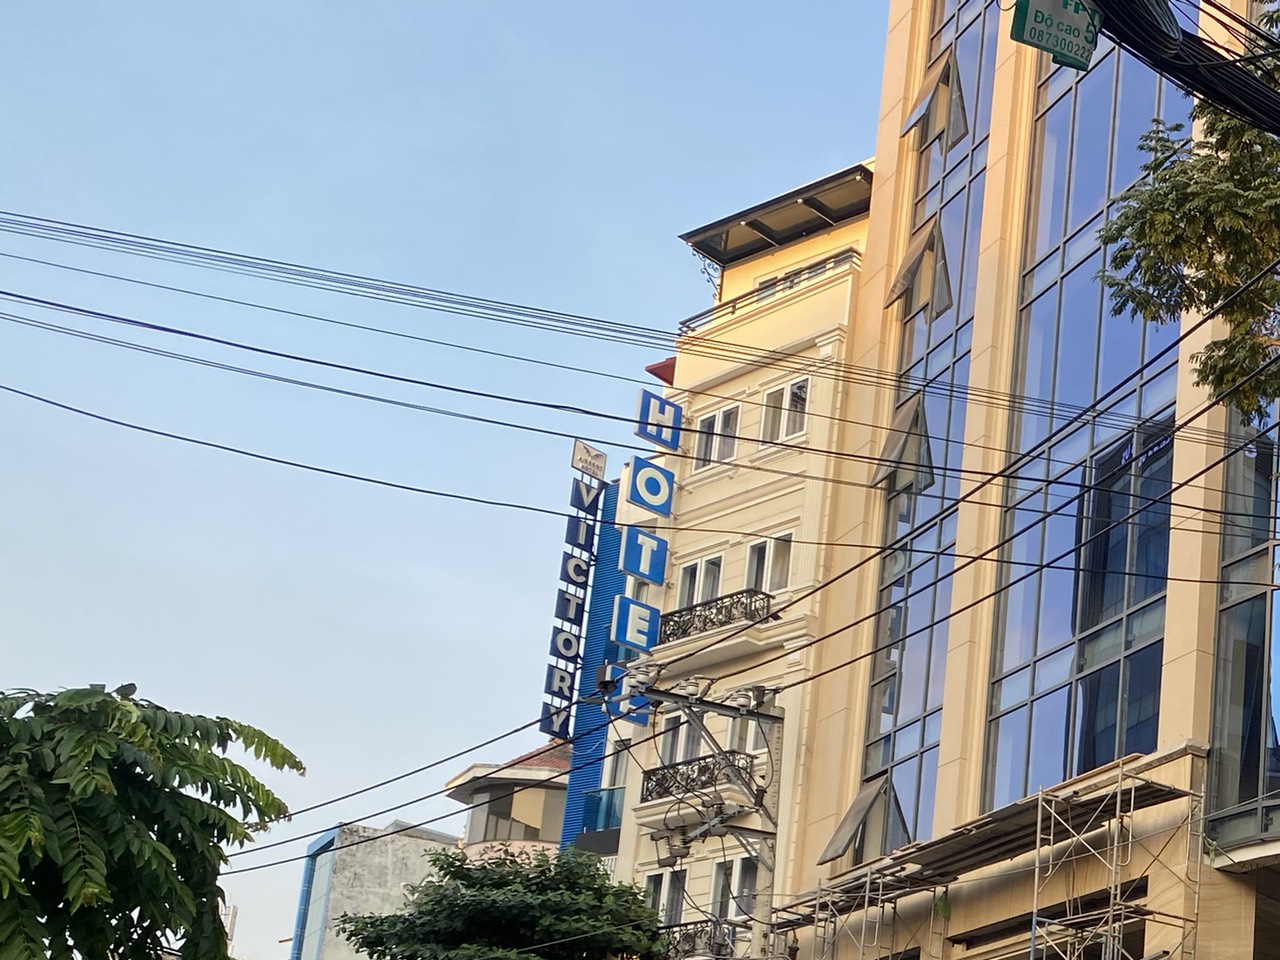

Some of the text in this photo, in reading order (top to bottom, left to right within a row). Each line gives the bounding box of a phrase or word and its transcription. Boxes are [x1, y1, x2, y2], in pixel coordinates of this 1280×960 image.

[1034, 9, 1053, 30] Độ
[1057, 21, 1081, 38] cao
[549, 481, 599, 734] VICTORY
